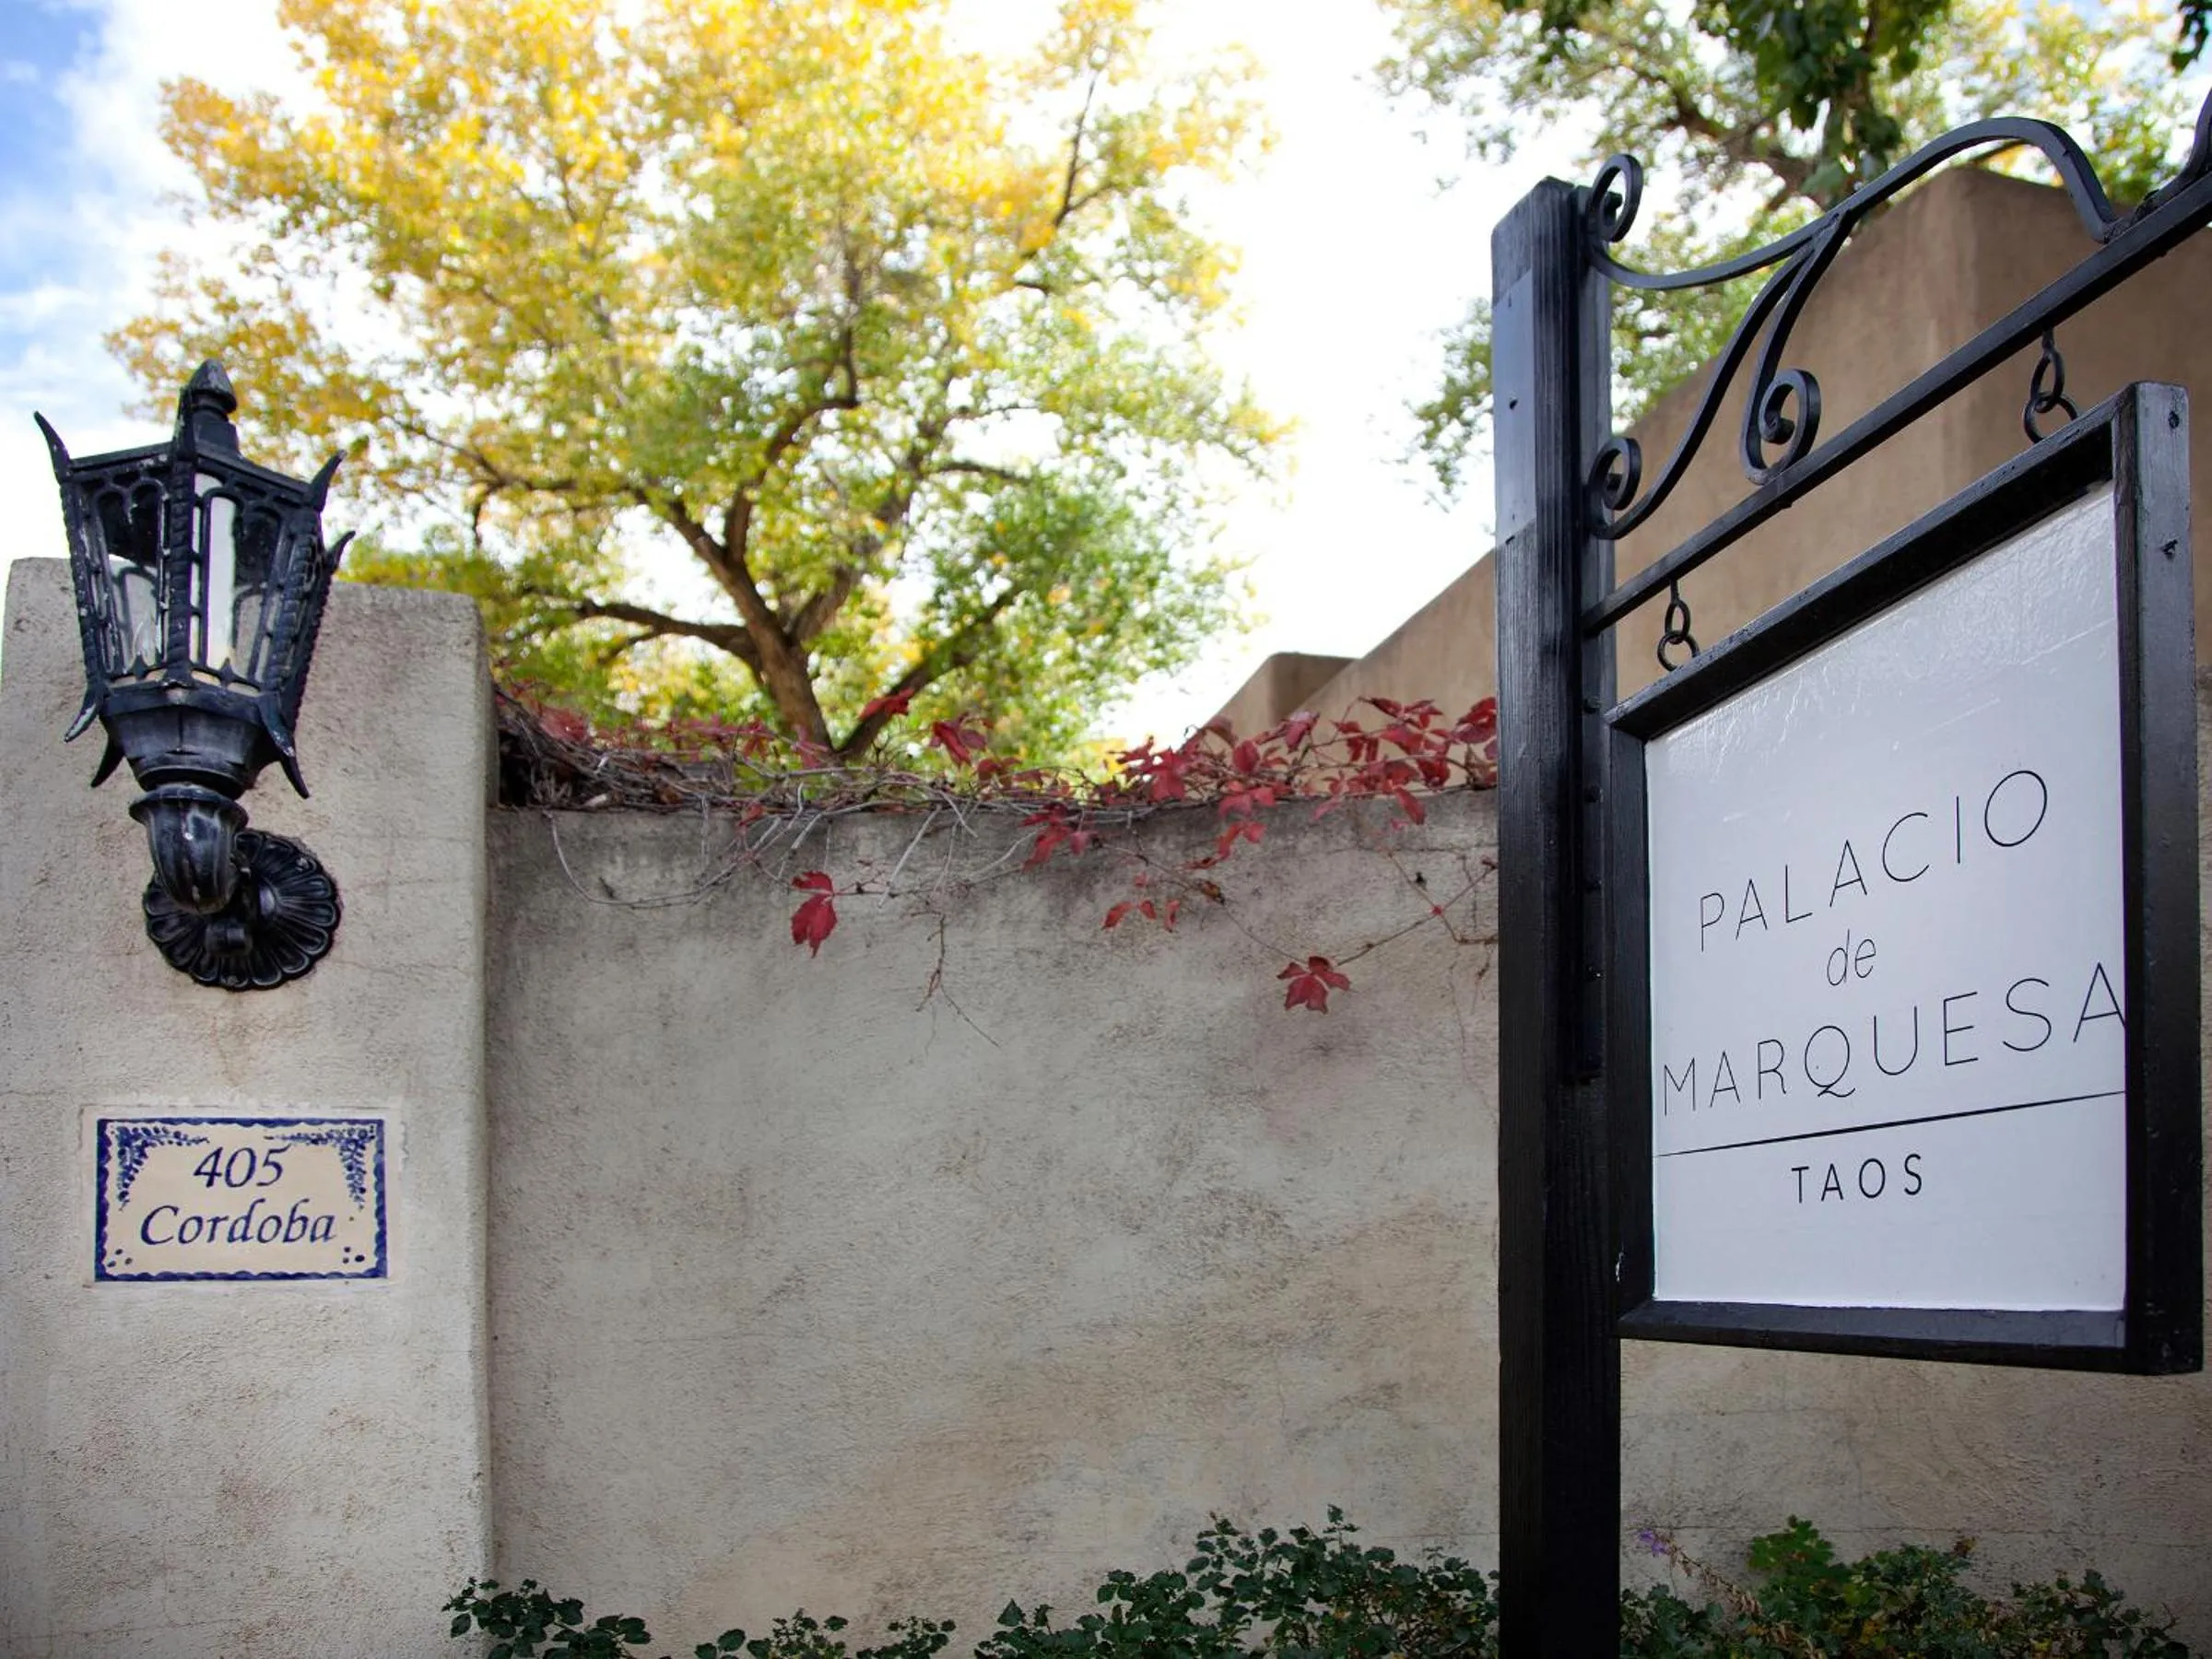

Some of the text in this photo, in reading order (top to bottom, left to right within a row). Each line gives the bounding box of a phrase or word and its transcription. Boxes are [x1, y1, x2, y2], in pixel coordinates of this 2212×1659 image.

[1699, 770, 2048, 953] PALACIO
[1826, 928, 1877, 986] de
[1663, 961, 2126, 1116] MARQUESA
[192, 1144, 292, 1188] 405
[1791, 1153, 1923, 1204] TAOS
[139, 1197, 338, 1246] Cordoba
